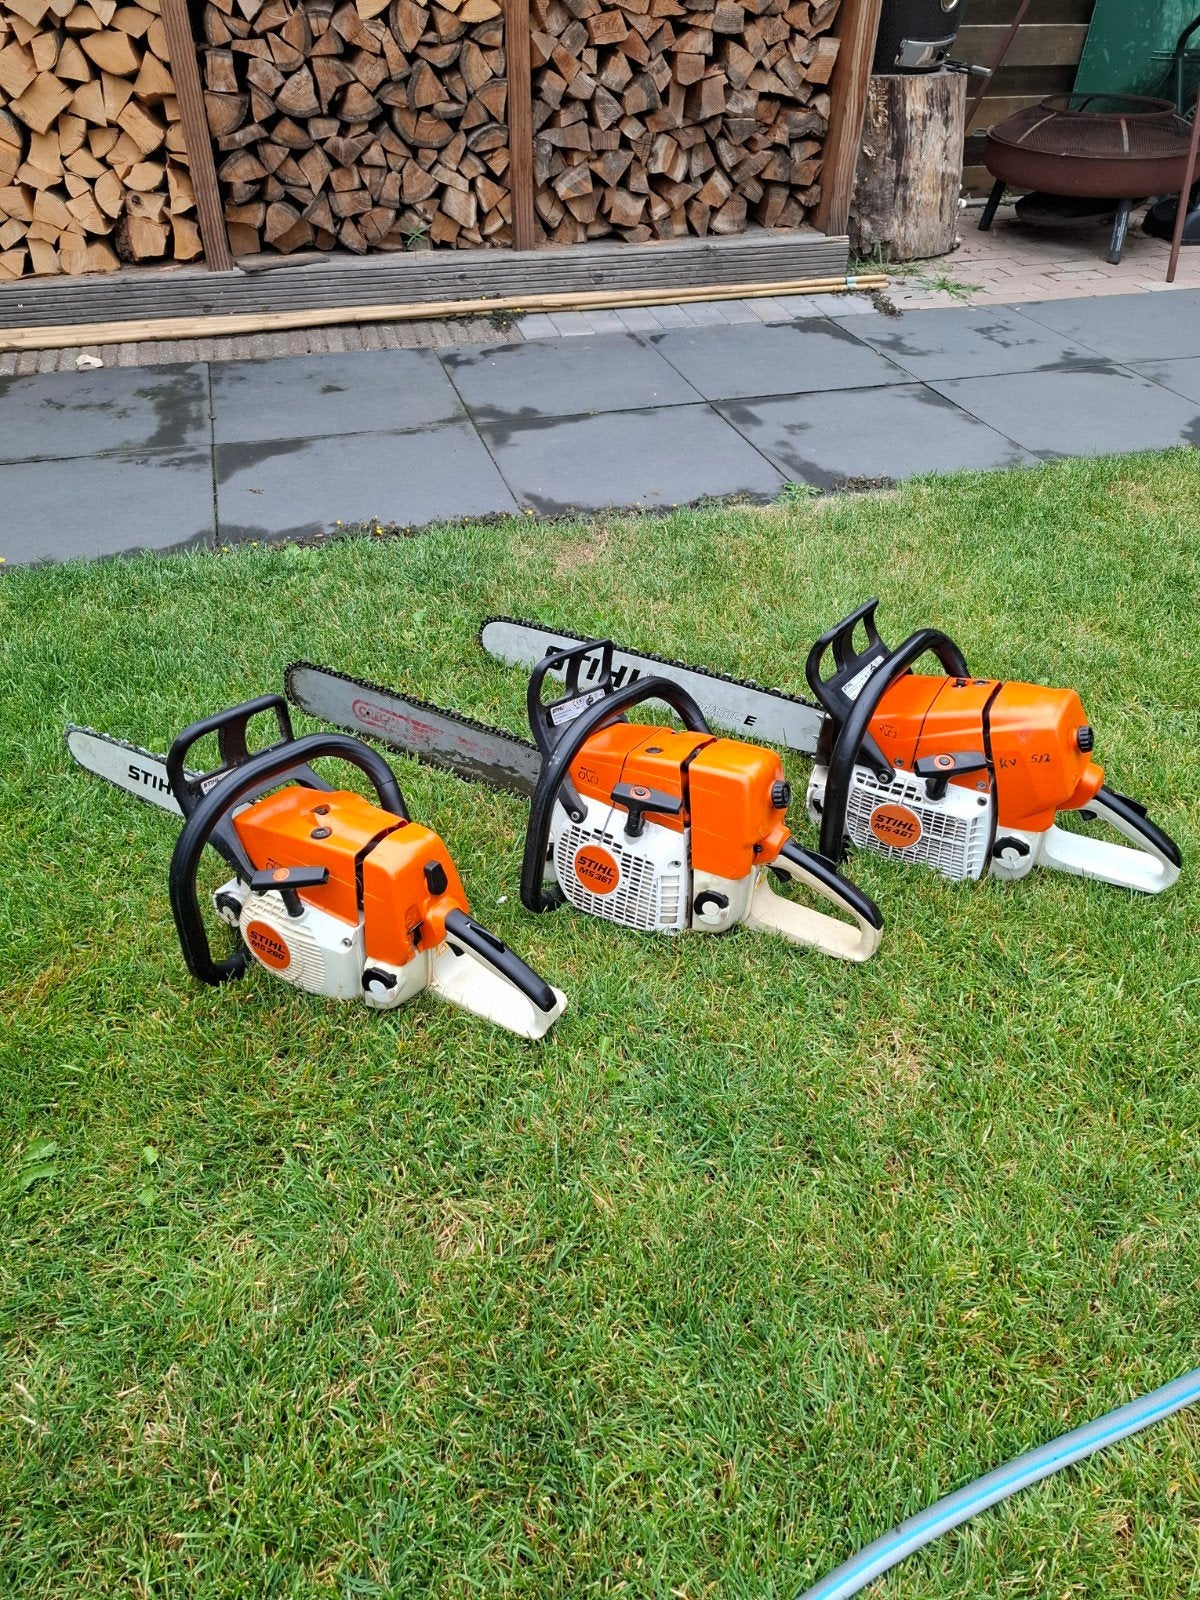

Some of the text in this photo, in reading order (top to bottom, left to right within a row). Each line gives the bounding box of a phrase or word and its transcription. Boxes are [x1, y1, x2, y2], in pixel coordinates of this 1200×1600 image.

[743, 715, 758, 726] E
[128, 765, 175, 798] STIH
[874, 823, 913, 839] MS 461
[875, 814, 916, 832] STIHL
[578, 856, 615, 878] STIHL
[579, 867, 613, 885] MS 361
[250, 930, 286, 955] STIHL
[251, 940, 285, 961] MS 260
